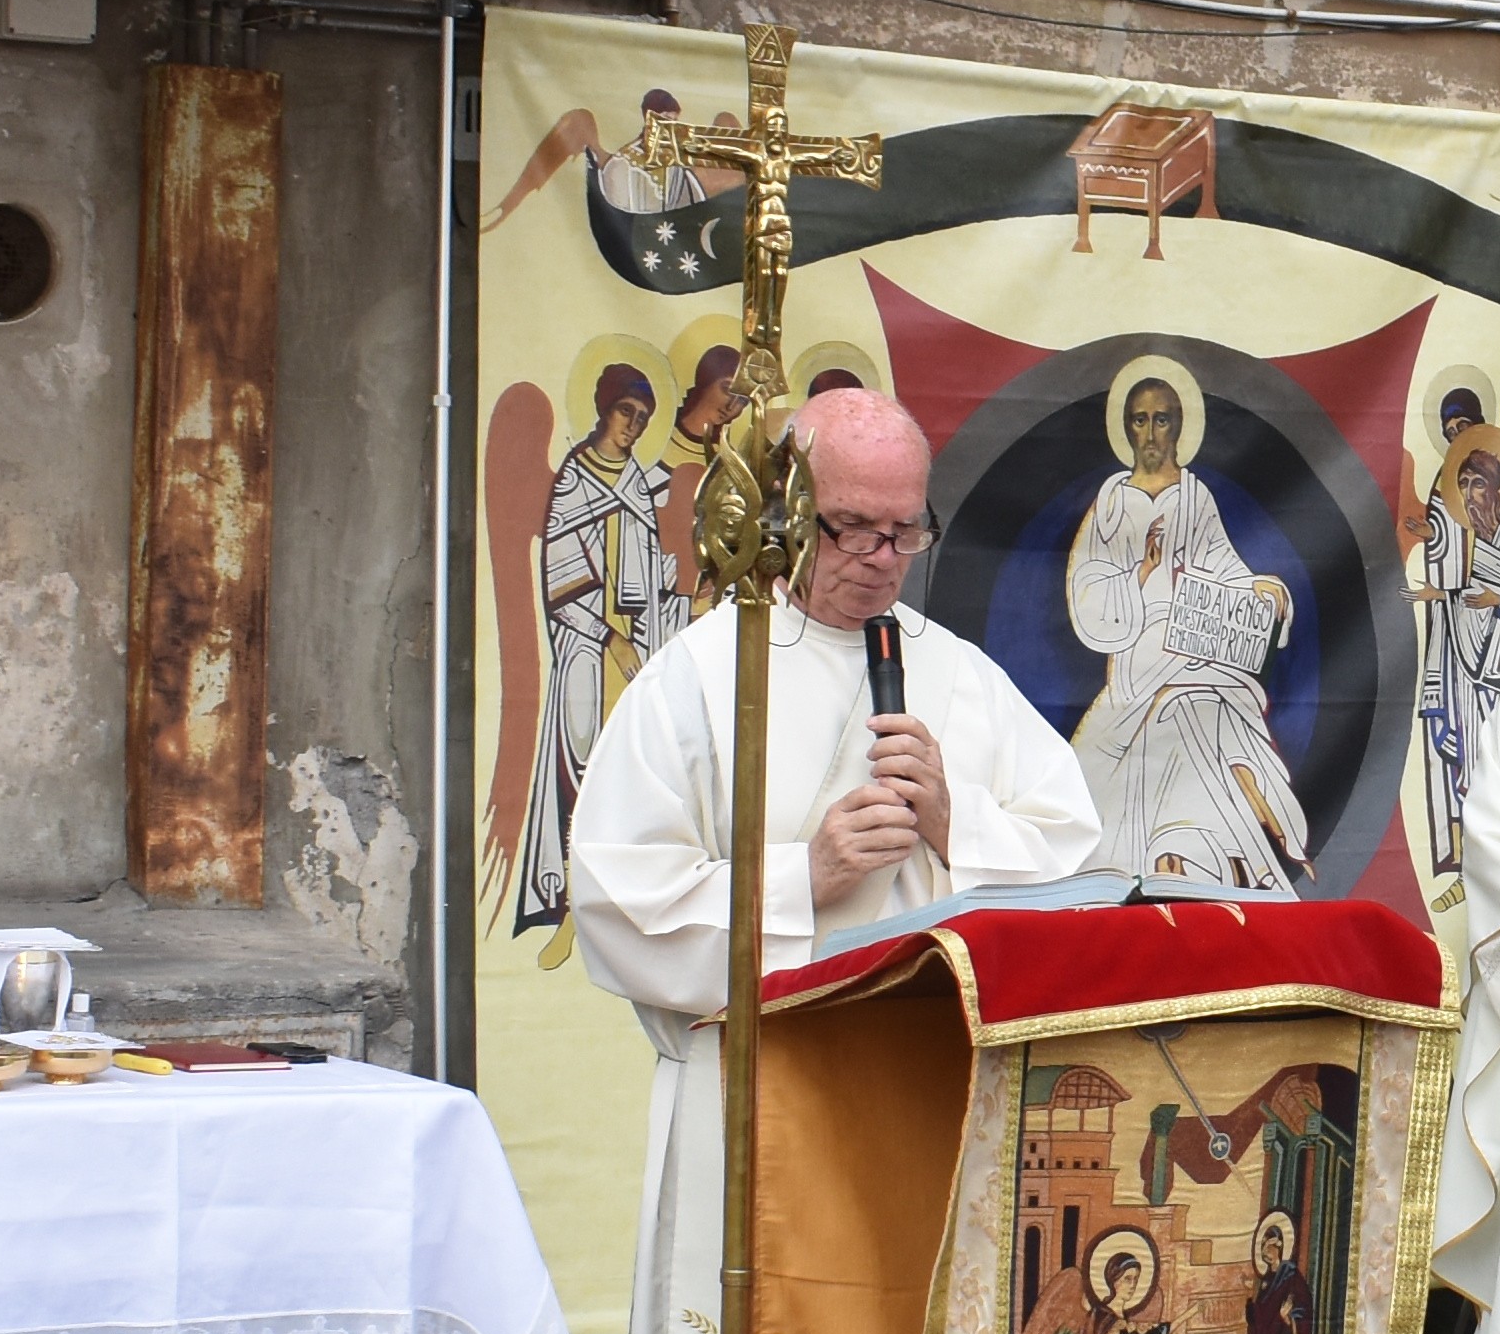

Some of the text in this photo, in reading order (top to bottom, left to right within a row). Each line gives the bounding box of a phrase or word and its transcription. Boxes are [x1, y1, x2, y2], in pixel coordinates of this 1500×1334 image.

[1176, 577, 1212, 610] AMAD
[1225, 589, 1273, 632] VENGO
[1218, 625, 1268, 672] PRONTO
